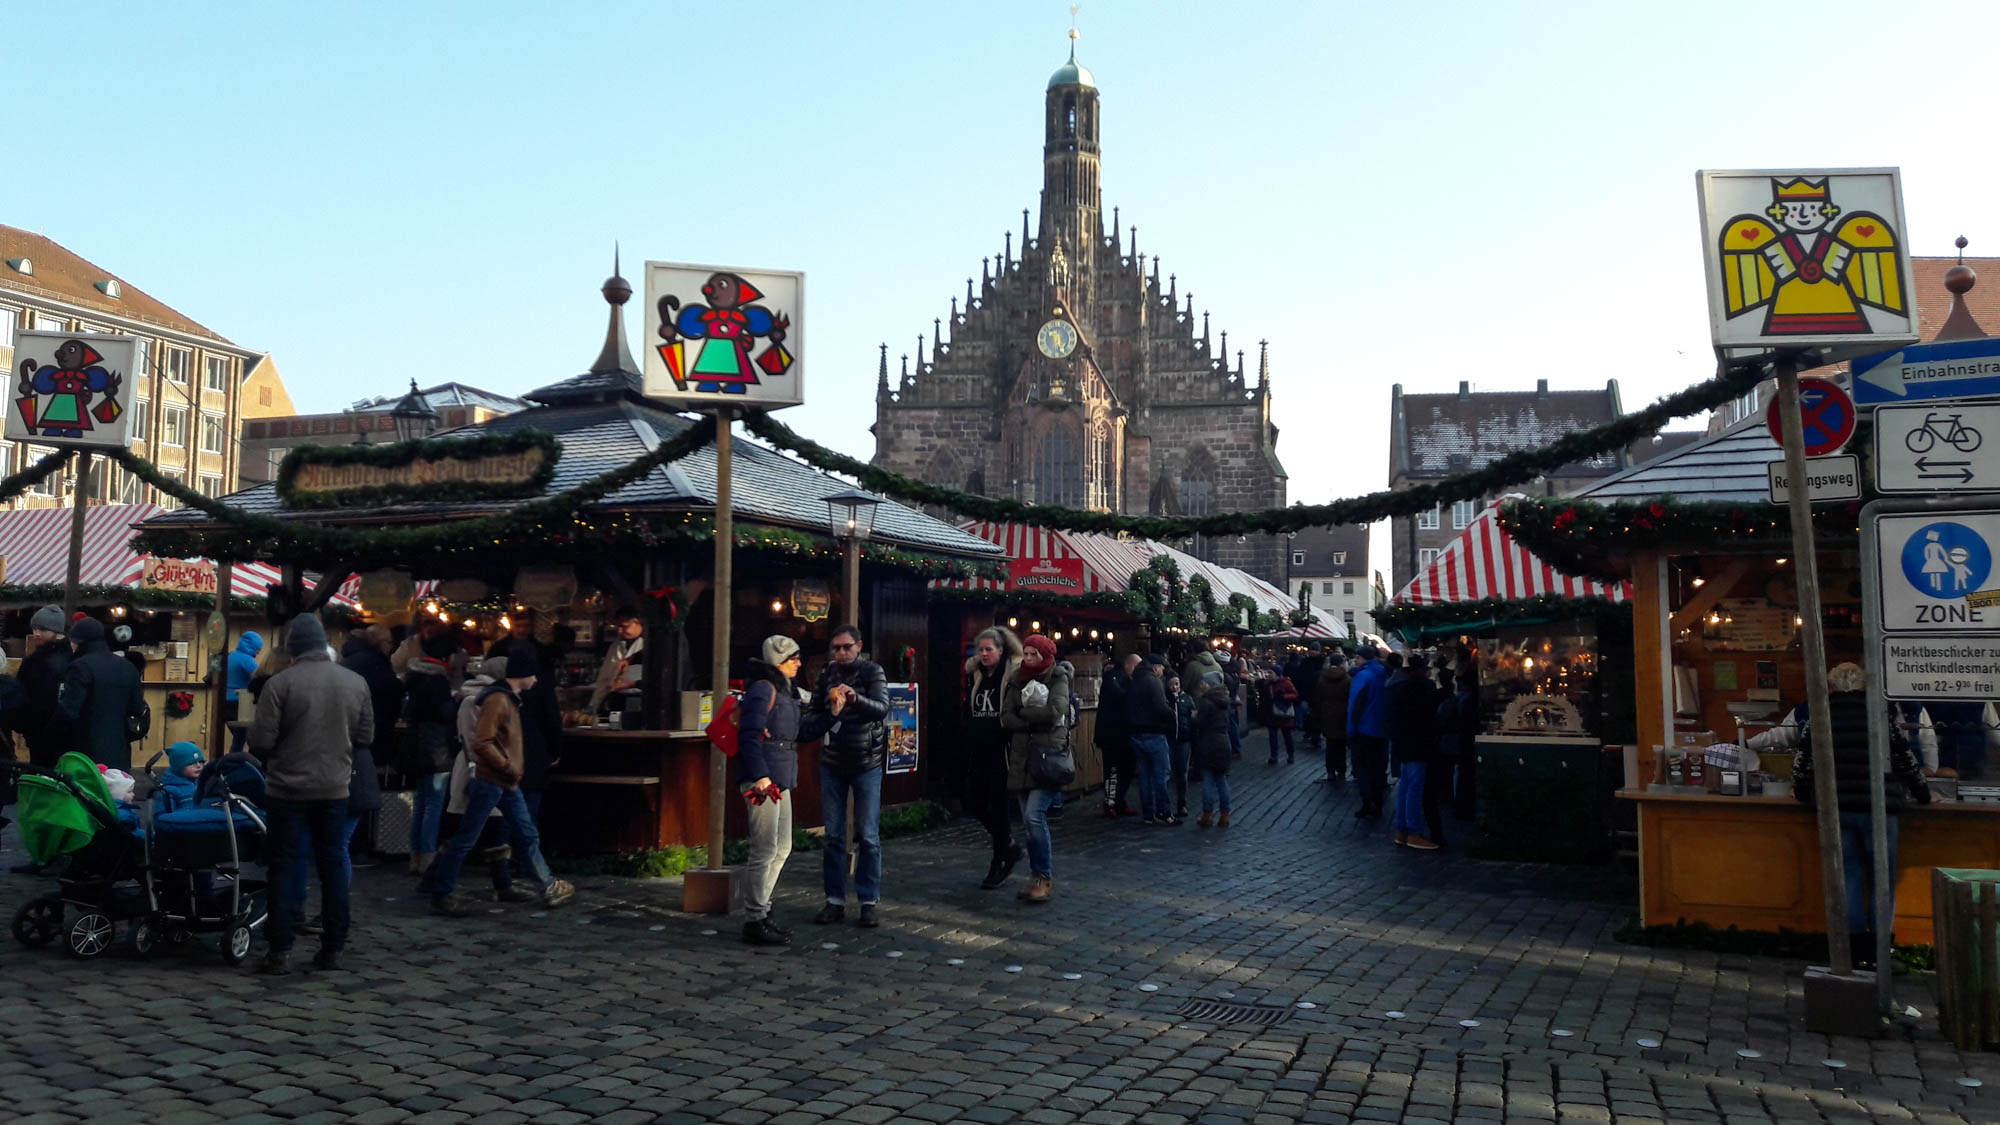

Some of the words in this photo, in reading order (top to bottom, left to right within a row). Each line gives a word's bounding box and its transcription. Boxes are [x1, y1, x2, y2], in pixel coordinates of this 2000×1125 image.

[1775, 473, 1854, 489] Rengsweg
[1915, 604, 1983, 623] ZONE
[1890, 645, 1986, 658] Marktbeschicker
[1911, 682, 1930, 692] von
[1975, 680, 1993, 692] frei
